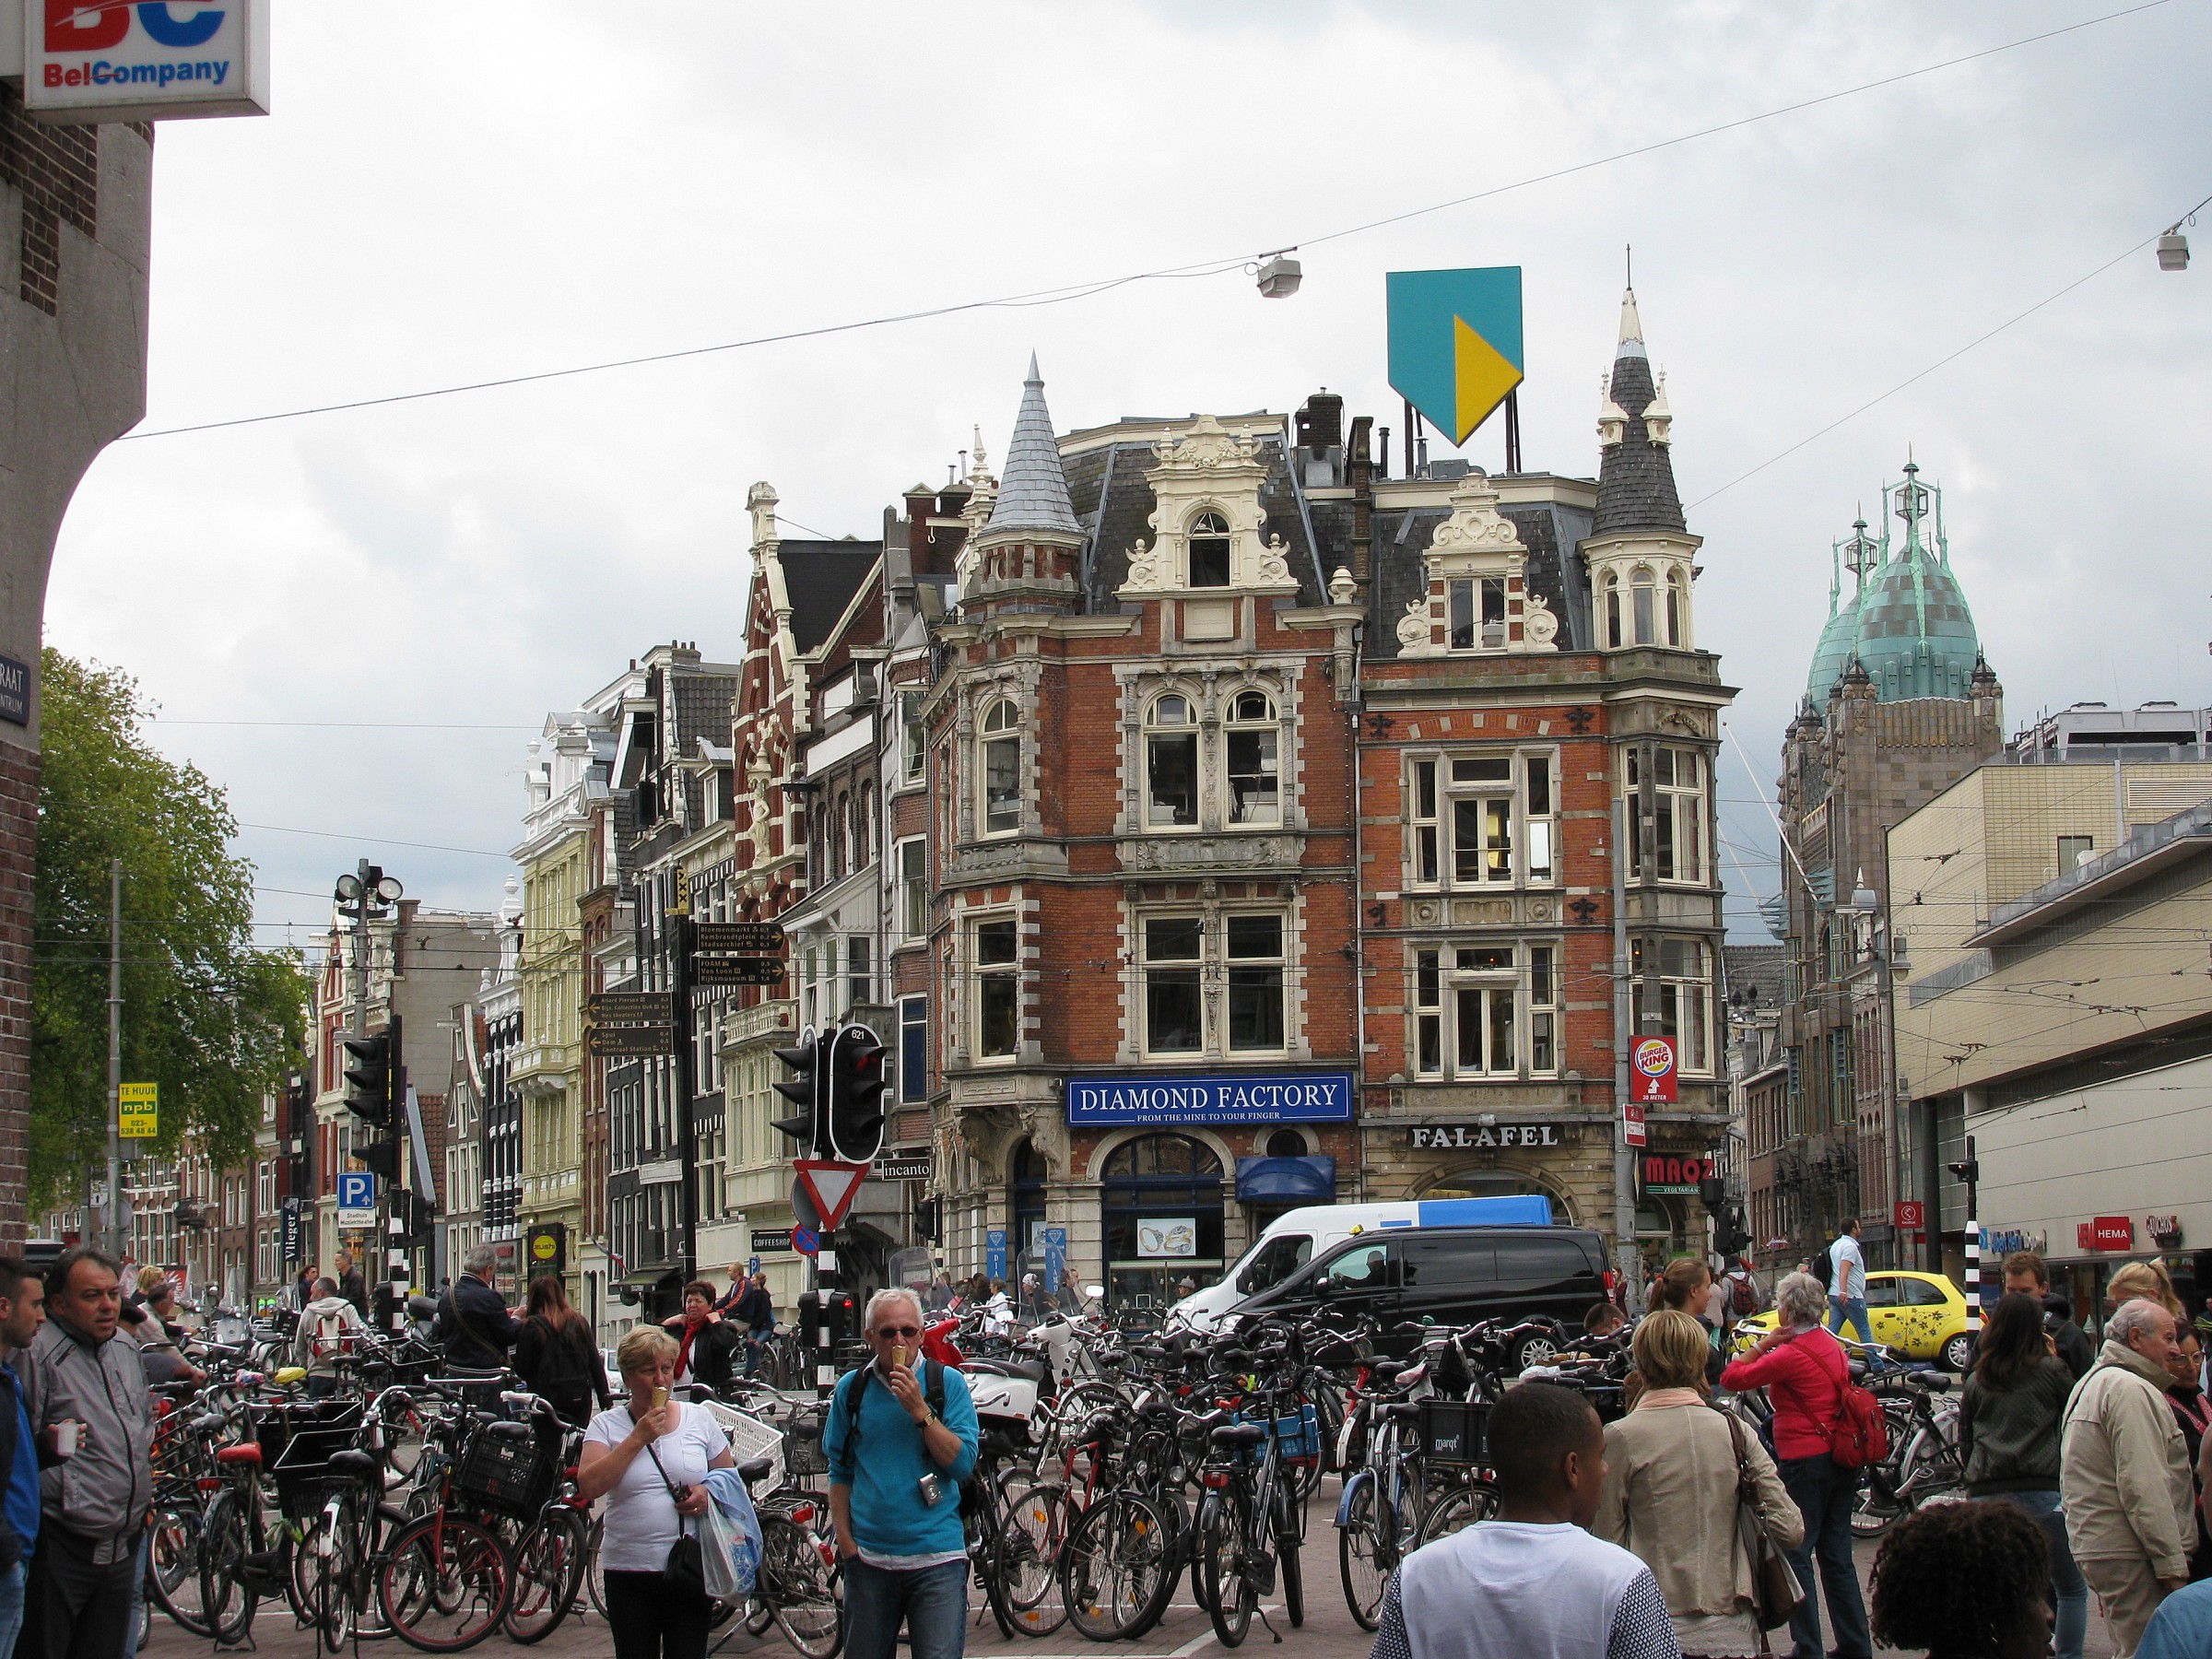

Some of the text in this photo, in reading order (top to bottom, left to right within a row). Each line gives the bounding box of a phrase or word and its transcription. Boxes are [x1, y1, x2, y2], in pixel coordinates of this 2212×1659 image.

[44, 61, 229, 88] BelCompany
[851, 1029, 865, 1040] 621
[1640, 1046, 1668, 1060] BURGER
[1641, 1053, 1669, 1069] KING
[133, 1087, 156, 1095] HUUR
[1080, 1084, 1338, 1111] DIAMOND FACTORY
[124, 1100, 153, 1114] npb
[1137, 1113, 1161, 1122] FROM
[1163, 1113, 1182, 1122] THE
[1207, 1112, 1220, 1121] TO
[1248, 1112, 1280, 1120] FINGER
[1412, 1126, 1559, 1148] FALAFEL
[885, 1163, 930, 1176] incanto
[1645, 1157, 1714, 1183] MAOZ
[346, 1178, 366, 1205] P
[285, 1214, 299, 1260] Vlieger
[2098, 1230, 2128, 1239] HEMA
[753, 1238, 791, 1247] COFFEESHOP
